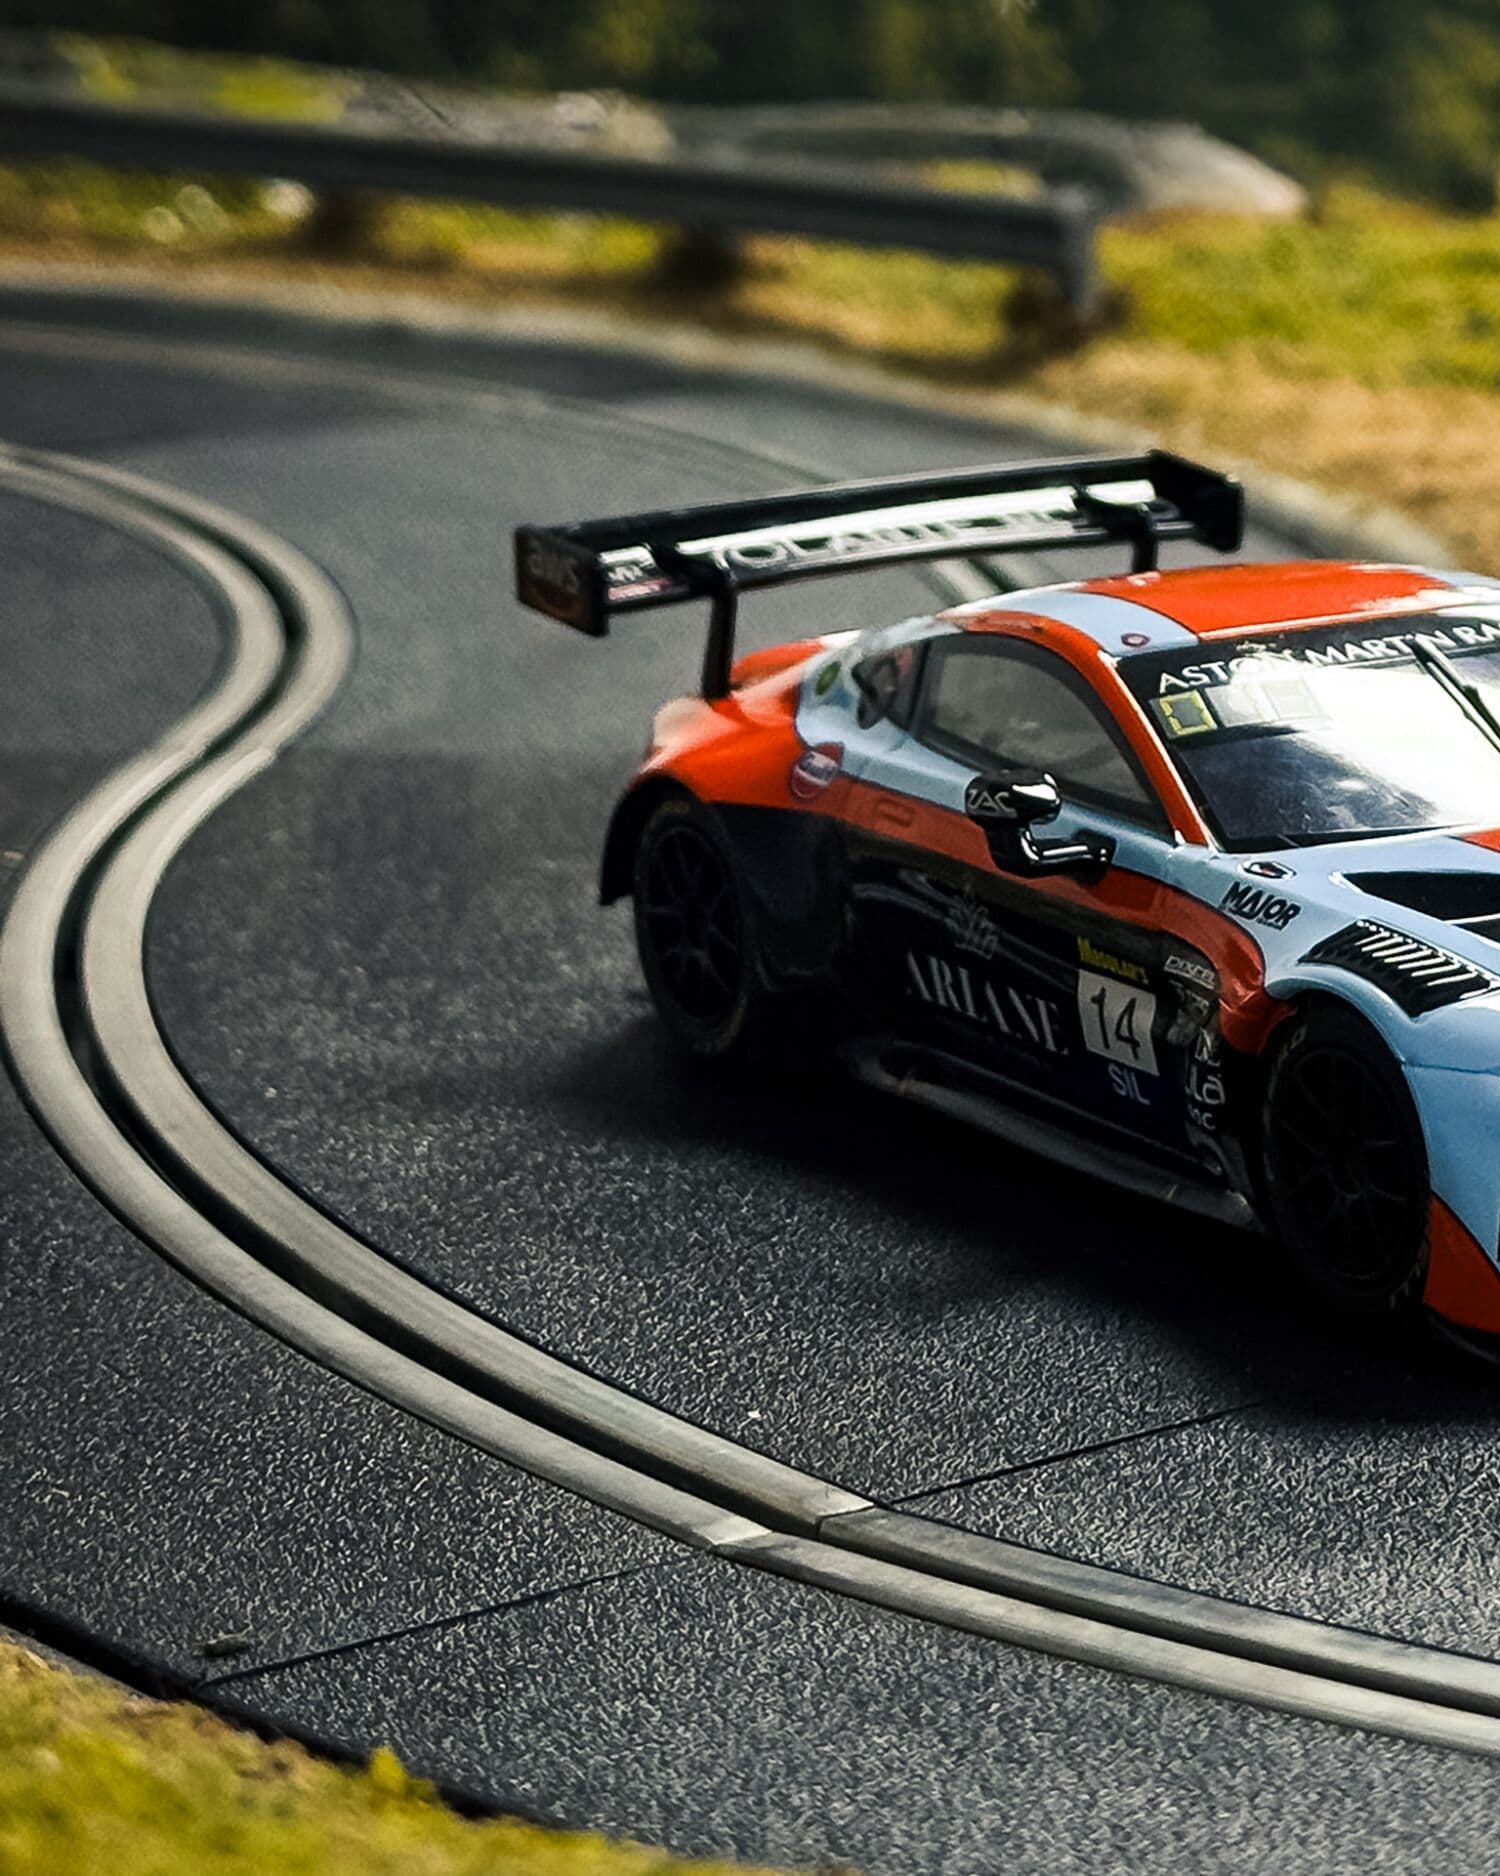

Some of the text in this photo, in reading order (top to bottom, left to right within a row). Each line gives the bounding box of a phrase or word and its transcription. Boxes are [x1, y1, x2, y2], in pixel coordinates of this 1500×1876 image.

[1304, 630, 1456, 667] MARTN
[1220, 881, 1302, 931] MAJOR
[1090, 985, 1141, 1060] 14
[1107, 1061, 1152, 1106] SIL
